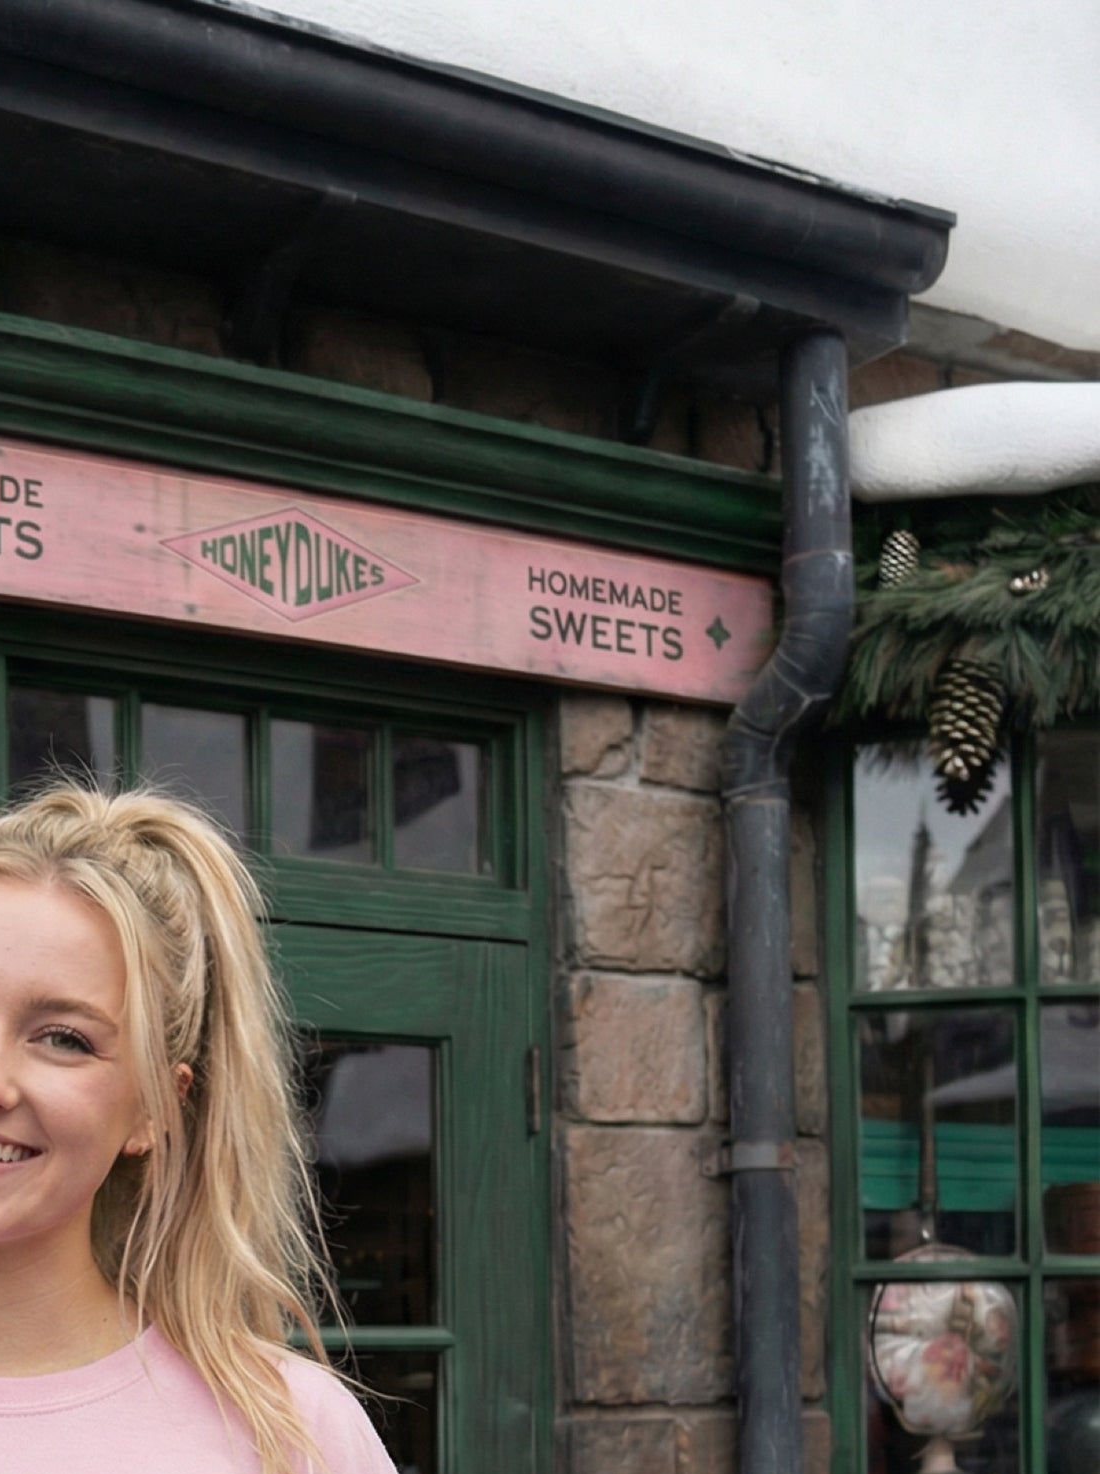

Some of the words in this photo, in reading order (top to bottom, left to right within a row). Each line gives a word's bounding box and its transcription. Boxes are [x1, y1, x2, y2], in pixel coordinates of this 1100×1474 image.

[201, 521, 385, 607] HONEYDUKES
[528, 565, 684, 616] HOMEMADE
[529, 605, 684, 661] SWEETS
